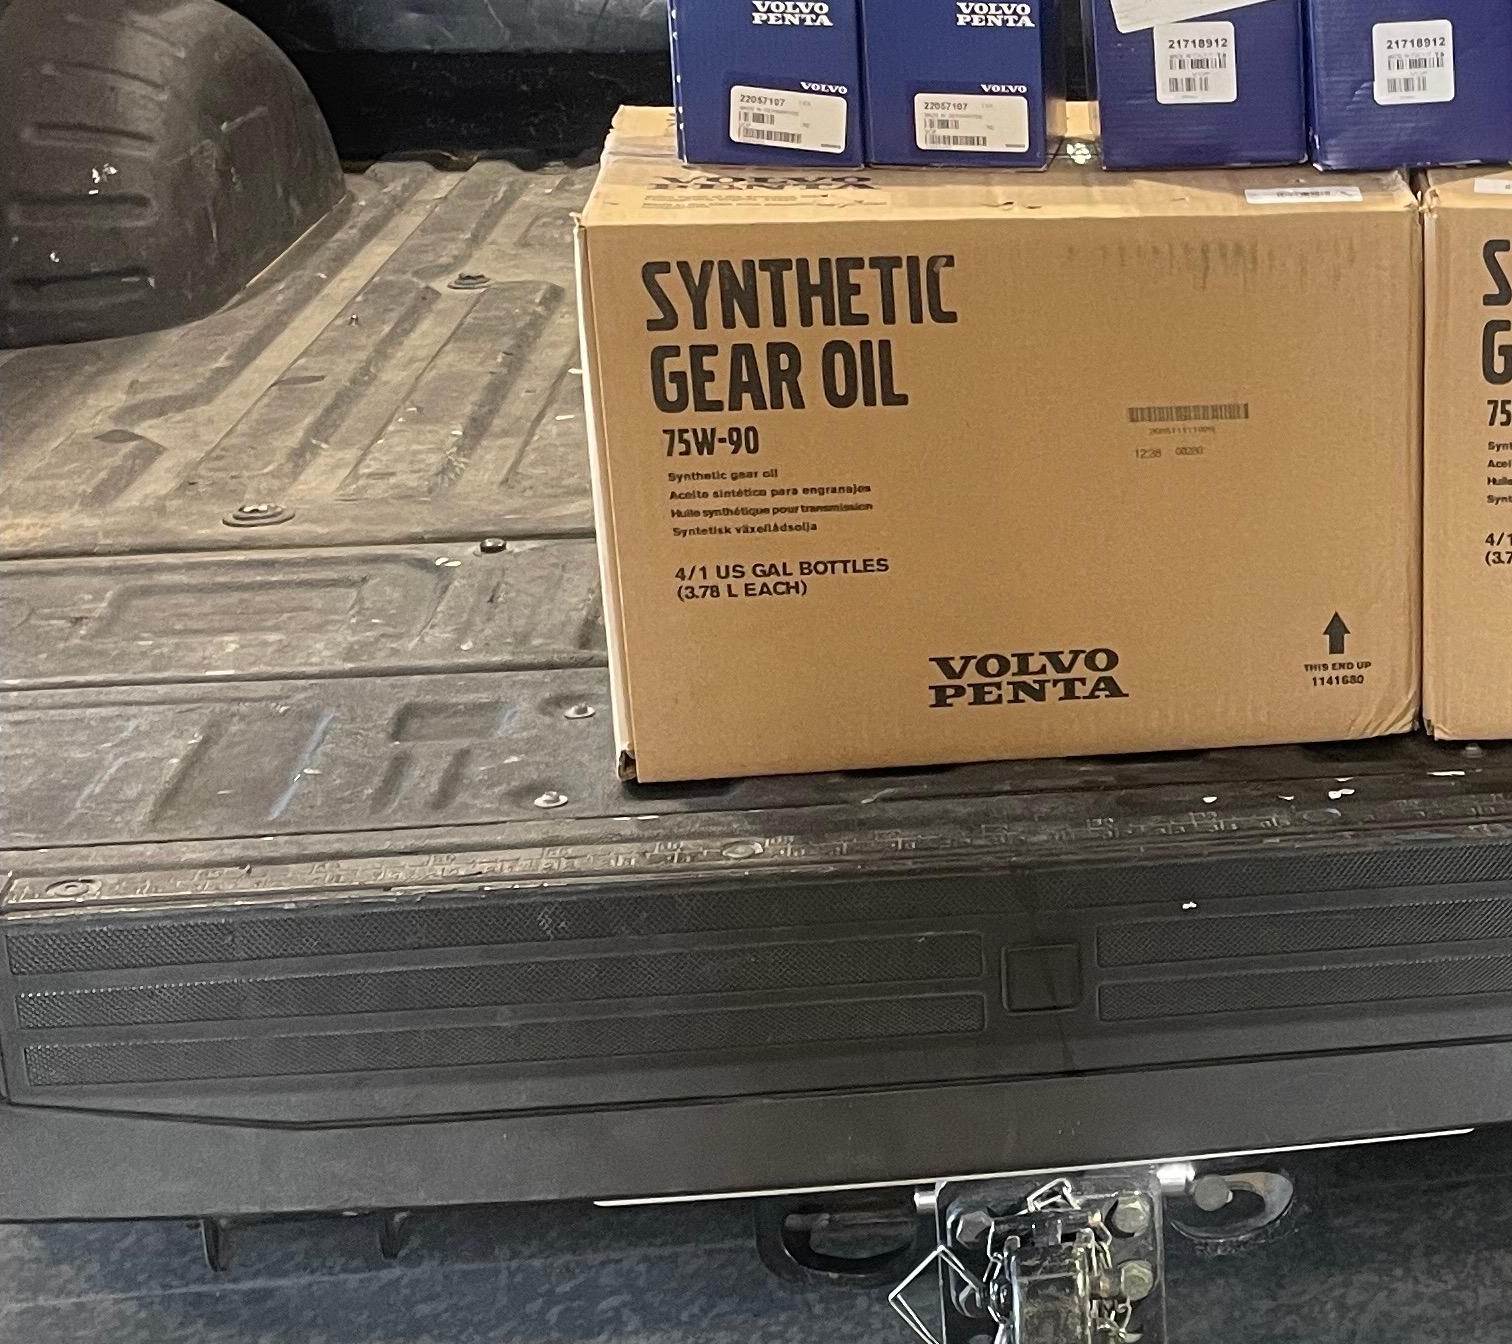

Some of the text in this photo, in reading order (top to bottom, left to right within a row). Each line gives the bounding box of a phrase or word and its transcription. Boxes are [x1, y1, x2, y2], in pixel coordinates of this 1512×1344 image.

[752, 0, 829, 14] VOLVO
[956, 1, 1031, 15] VOLVO
[752, 12, 833, 26] PENTA
[956, 14, 1035, 27] PENTA
[1168, 38, 1228, 49] 21718912
[1386, 37, 1446, 49] 21718912
[800, 81, 848, 95] VOLVO
[980, 83, 1028, 94] VOLVO
[641, 255, 958, 331] SYNTHETIC
[650, 339, 909, 413] GEAR OIL
[662, 425, 759, 456] 75W-90
[667, 468, 778, 484] Synthetic gear oil
[770, 486, 798, 498] para
[802, 483, 872, 496] engranajes
[772, 506, 799, 516] pour
[672, 524, 732, 538] Syntetisk
[675, 557, 890, 582] 4/1 US GAL BOTTLES
[676, 580, 808, 603] (3.78 L EACH)
[929, 648, 1119, 680] VOLVO
[1303, 661, 1372, 672] THIS END UP
[929, 675, 1129, 707] PENTA
